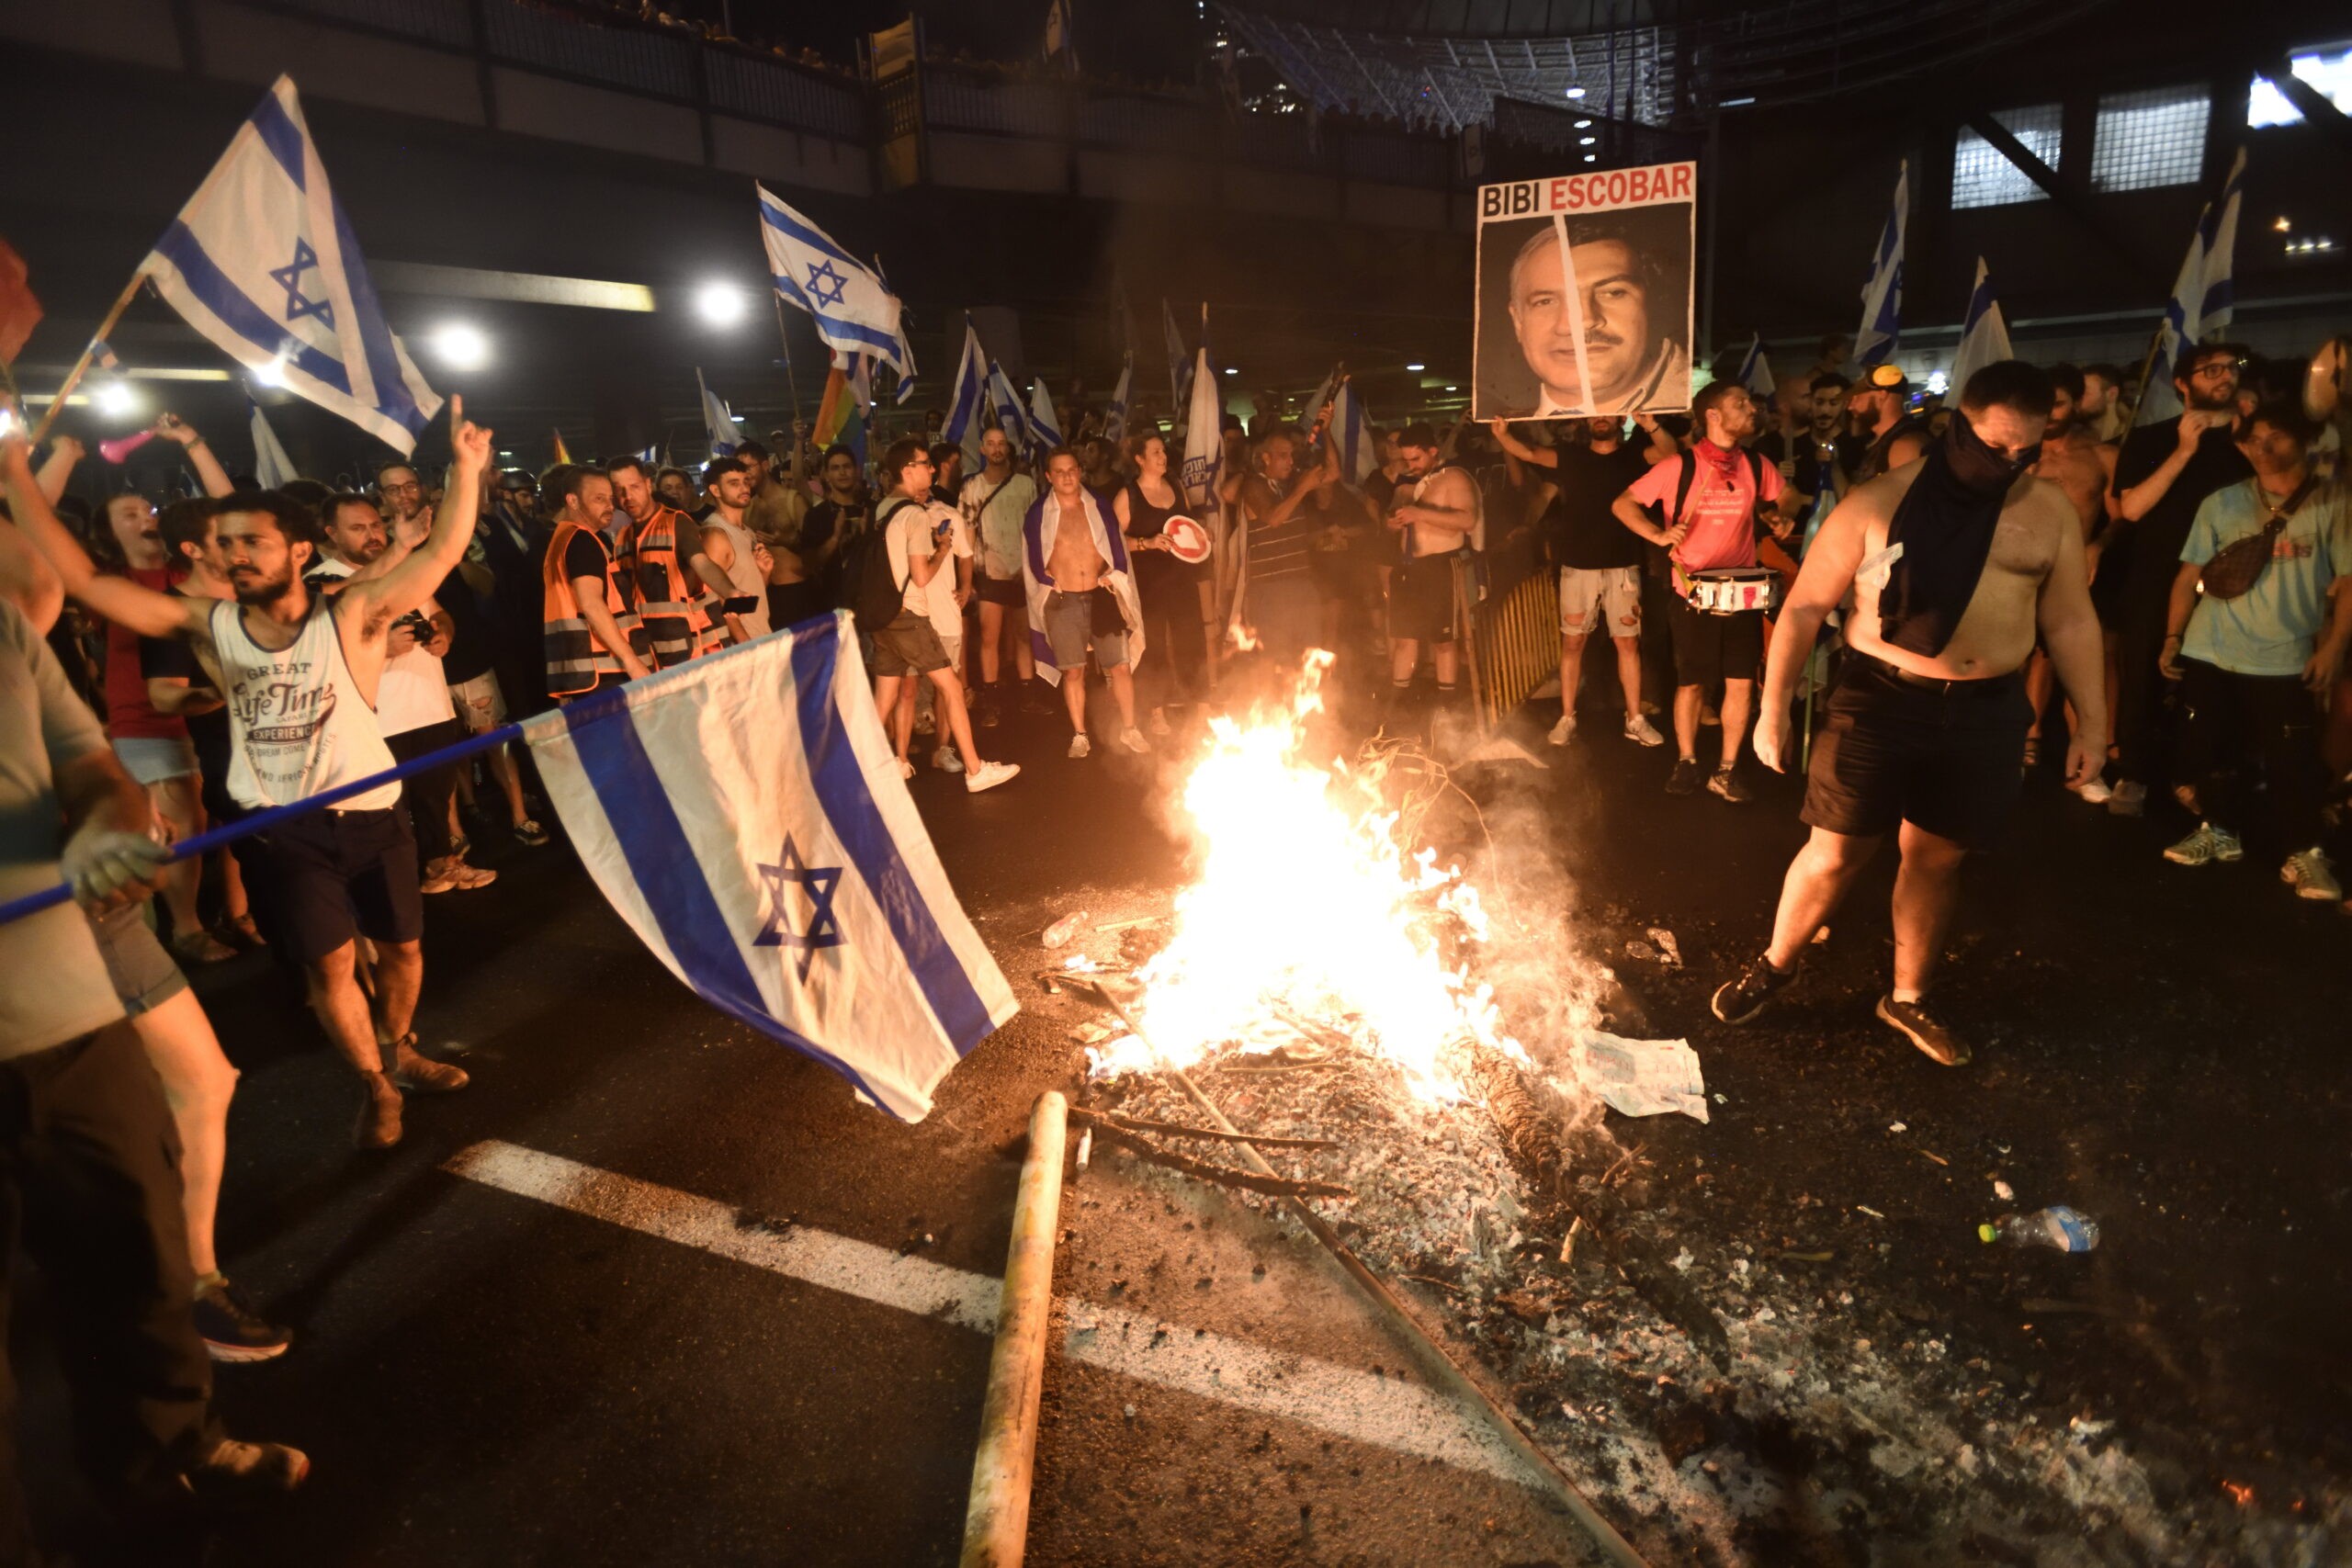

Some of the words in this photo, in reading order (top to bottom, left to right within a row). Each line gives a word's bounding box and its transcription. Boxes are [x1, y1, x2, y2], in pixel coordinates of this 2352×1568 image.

[1483, 181, 1541, 217] BIBI
[1550, 164, 1692, 211] ESCOBAR
[246, 662, 312, 681] GREAT
